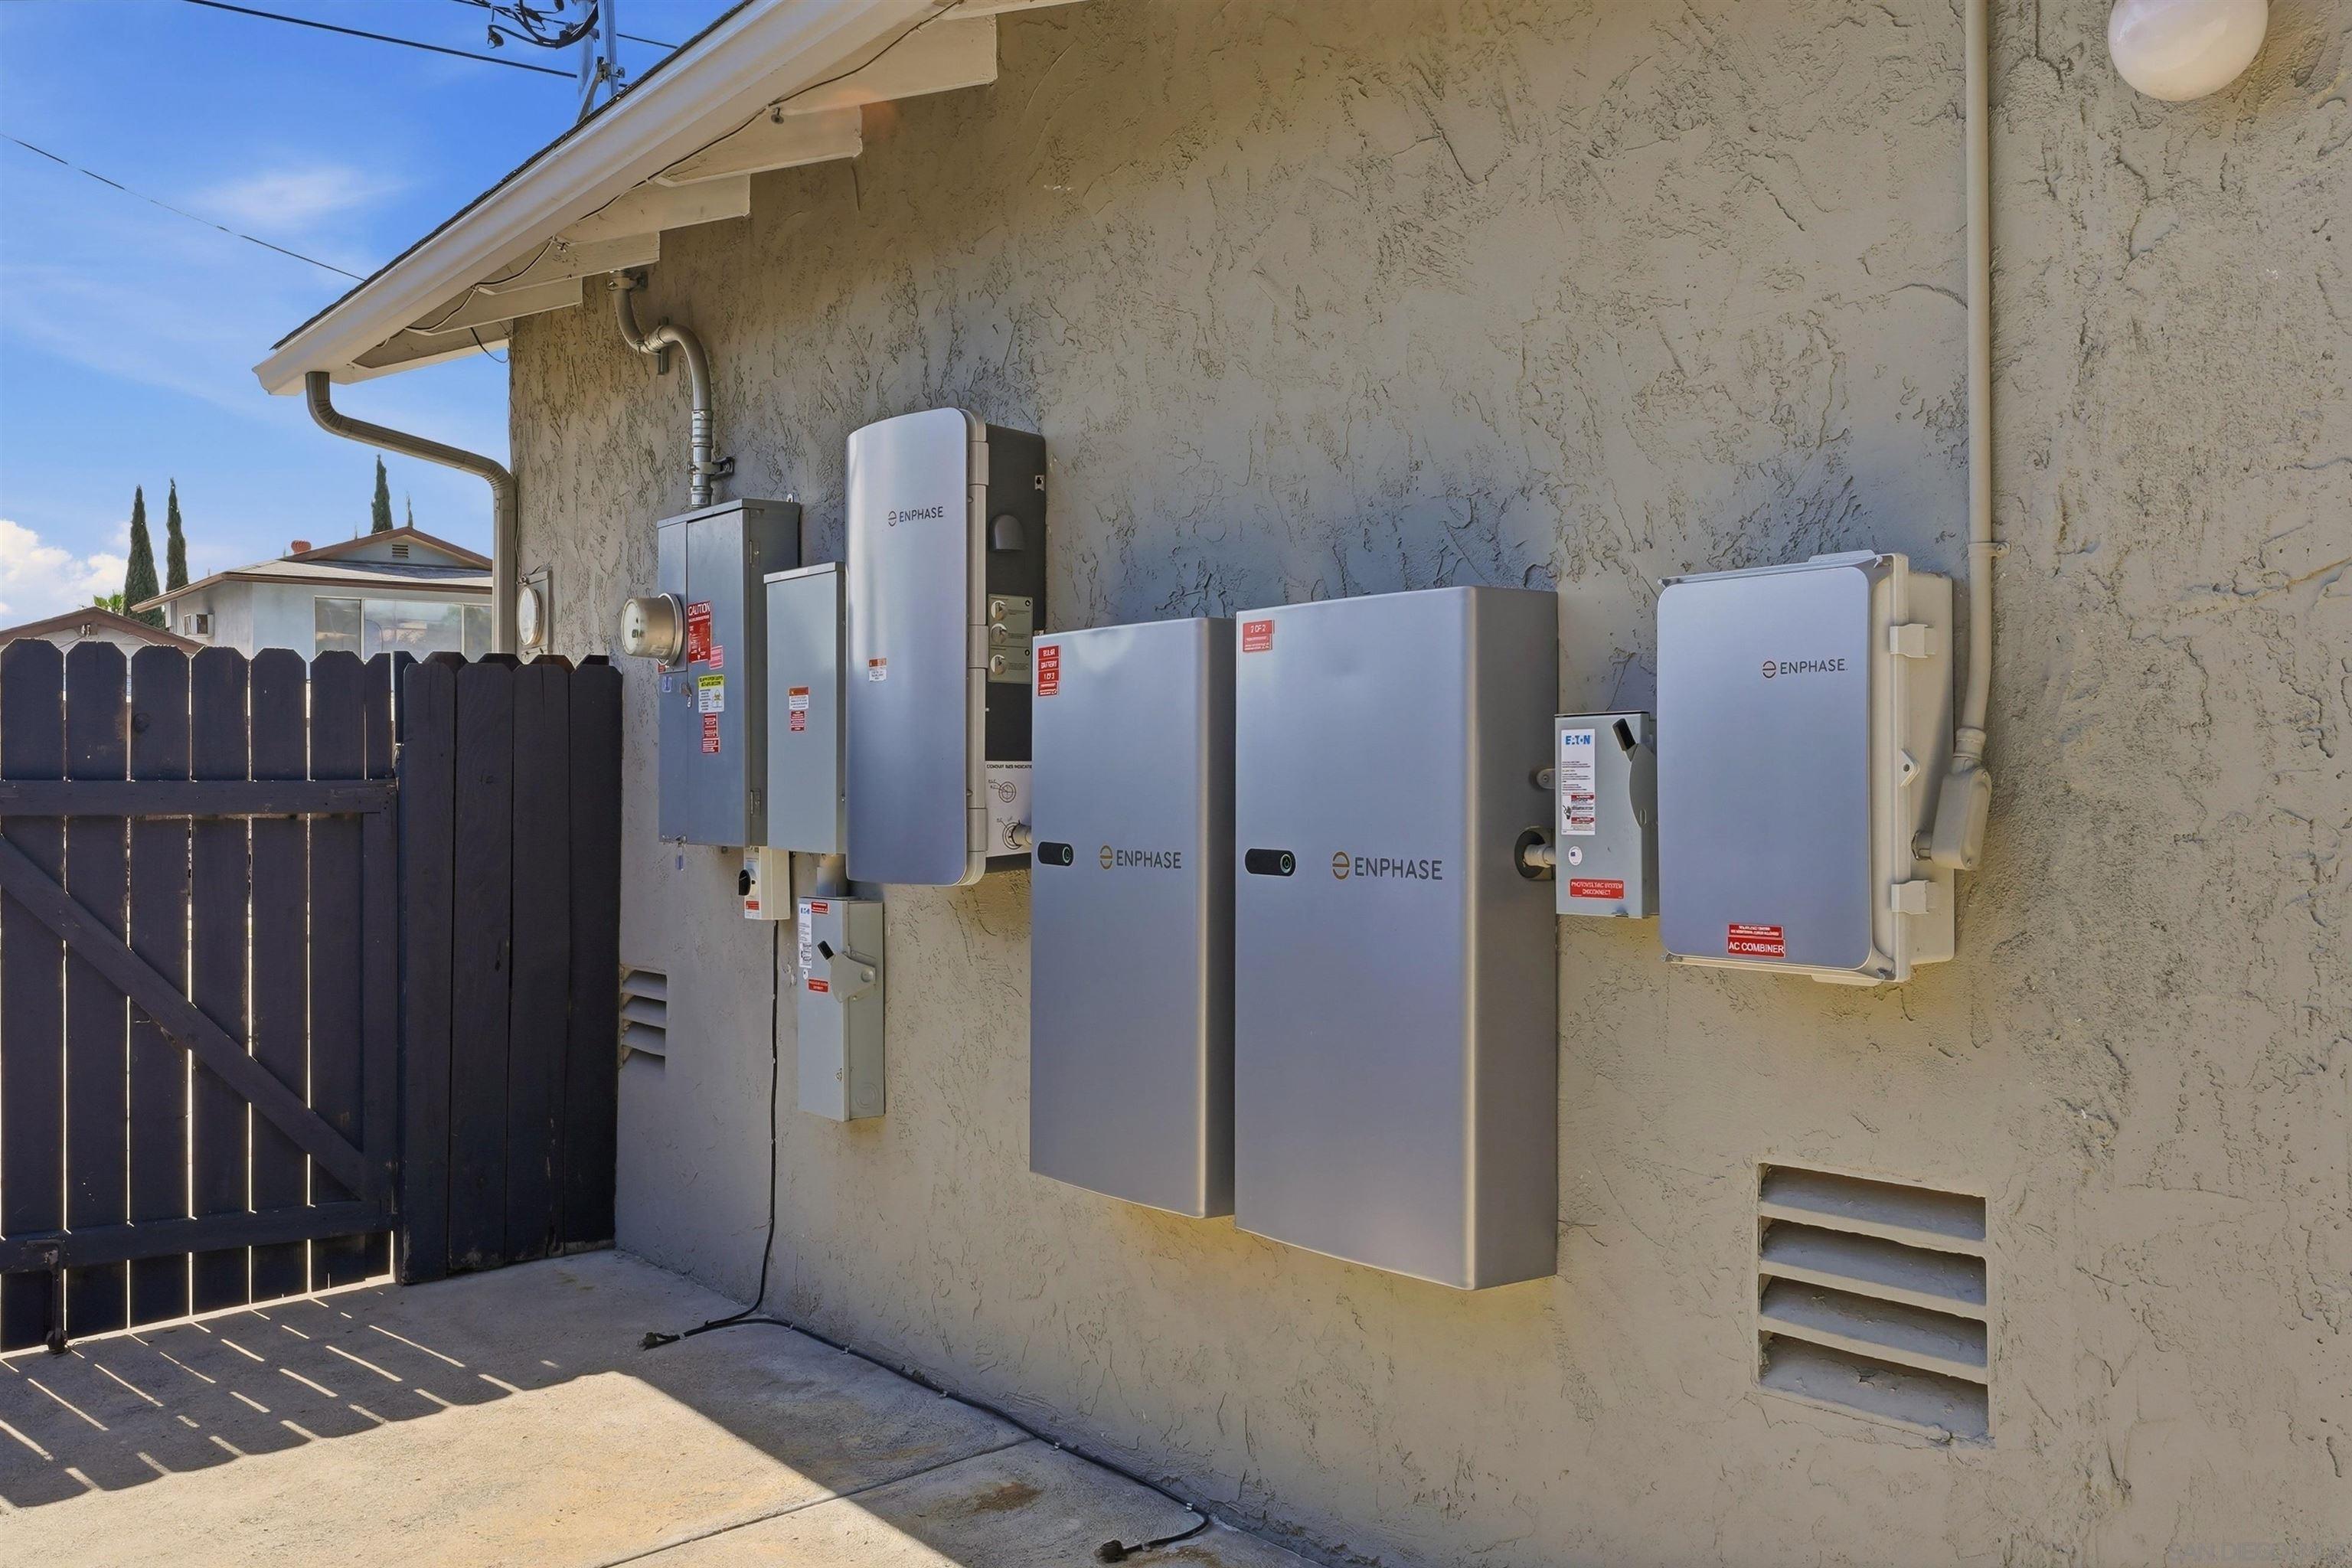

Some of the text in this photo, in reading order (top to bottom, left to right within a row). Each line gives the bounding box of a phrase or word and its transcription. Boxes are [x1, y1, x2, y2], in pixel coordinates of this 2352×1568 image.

[899, 506, 944, 522] ENPHASE
[688, 603, 710, 616] CAUTION
[1780, 658, 1846, 675] ENPHASE
[1116, 850, 1181, 869] ENPHASE
[1354, 857, 1443, 880] ENPHASE
[1728, 942, 1785, 953] AC COMBINER
